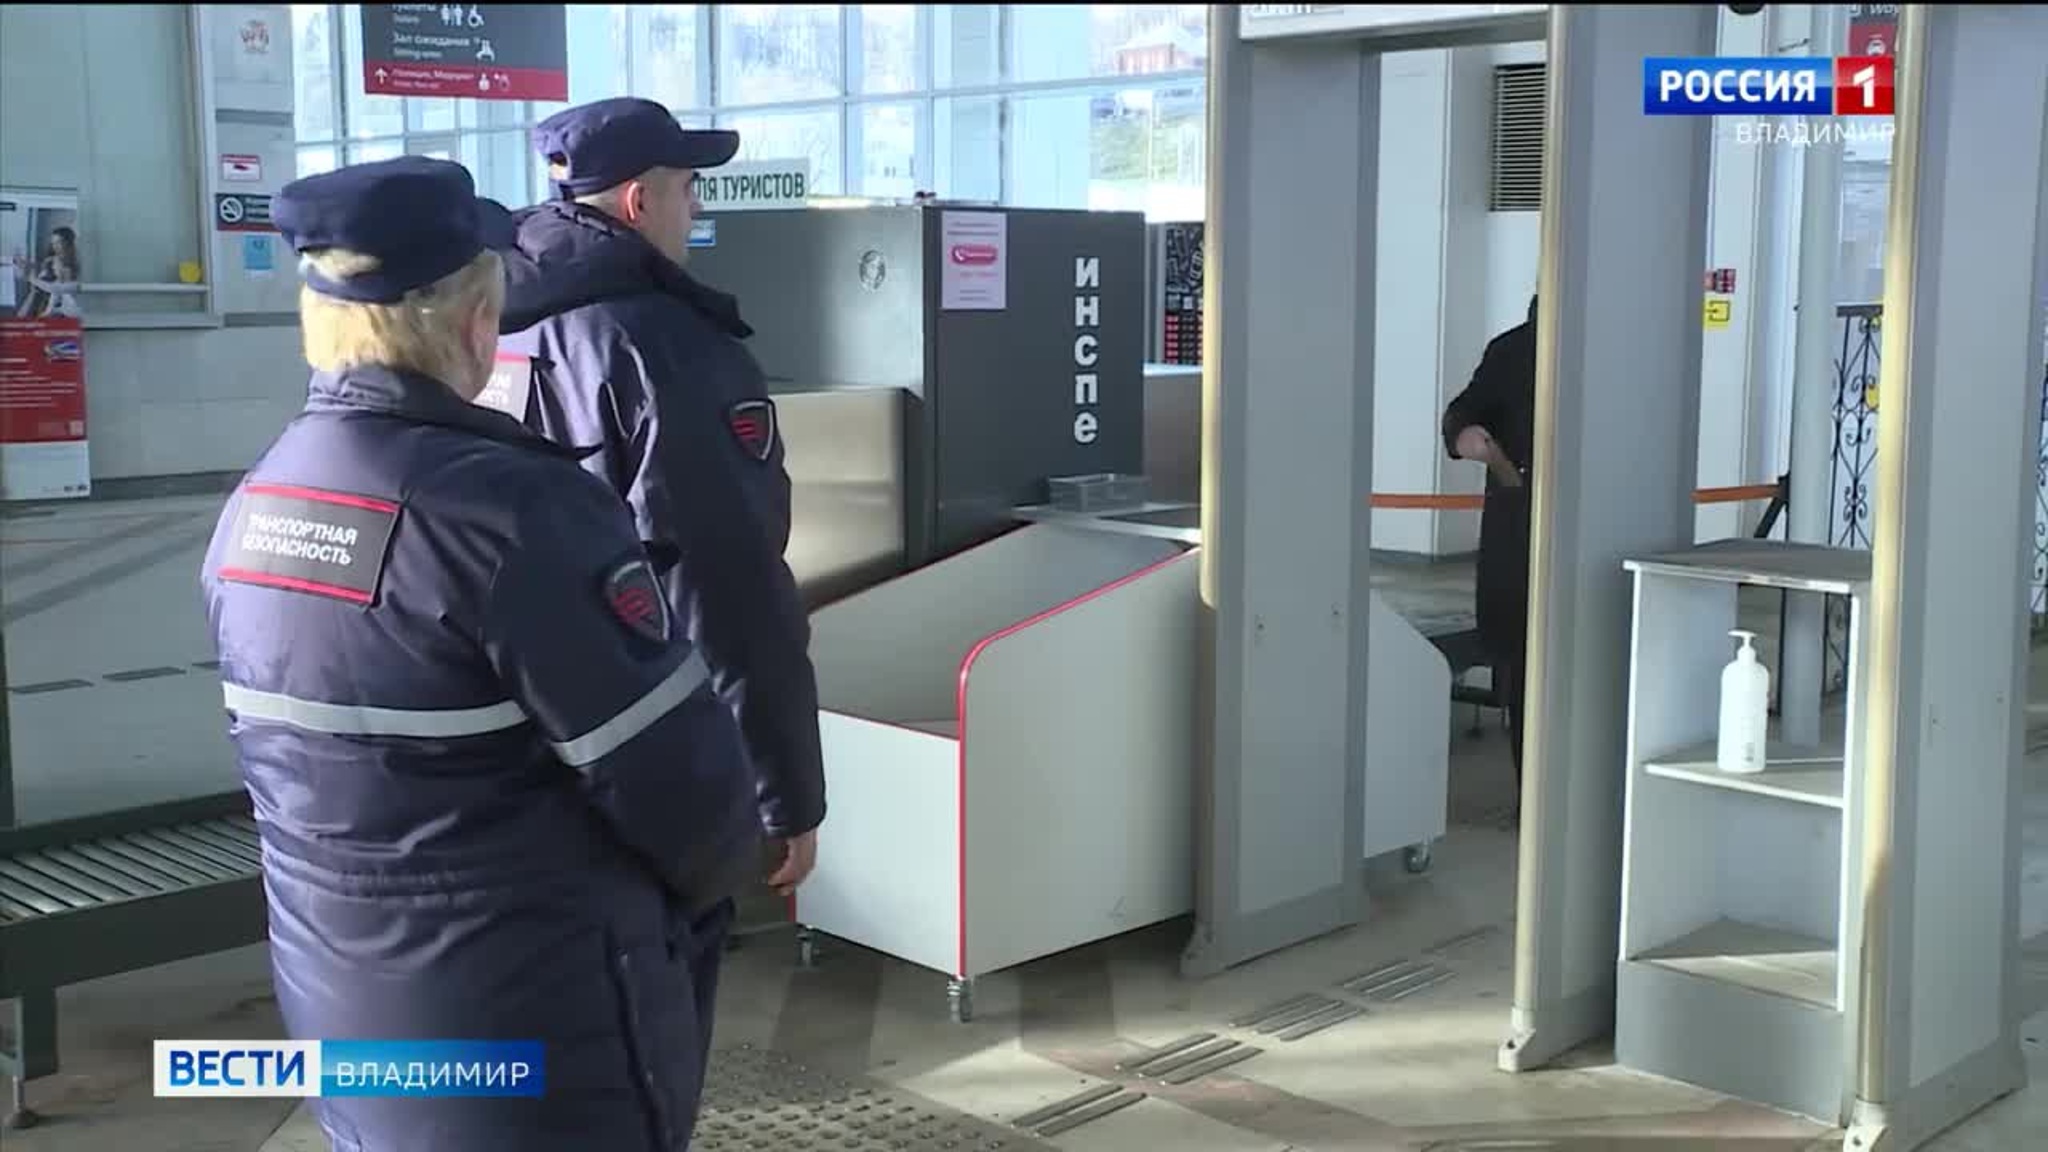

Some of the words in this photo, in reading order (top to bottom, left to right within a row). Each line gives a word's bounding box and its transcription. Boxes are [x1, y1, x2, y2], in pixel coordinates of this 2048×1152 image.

[694, 176, 718, 202] ЛЯ
[722, 172, 805, 201] ТУРИСТОВ
[241, 534, 353, 566] БЕЗОПАСНОСТЬ
